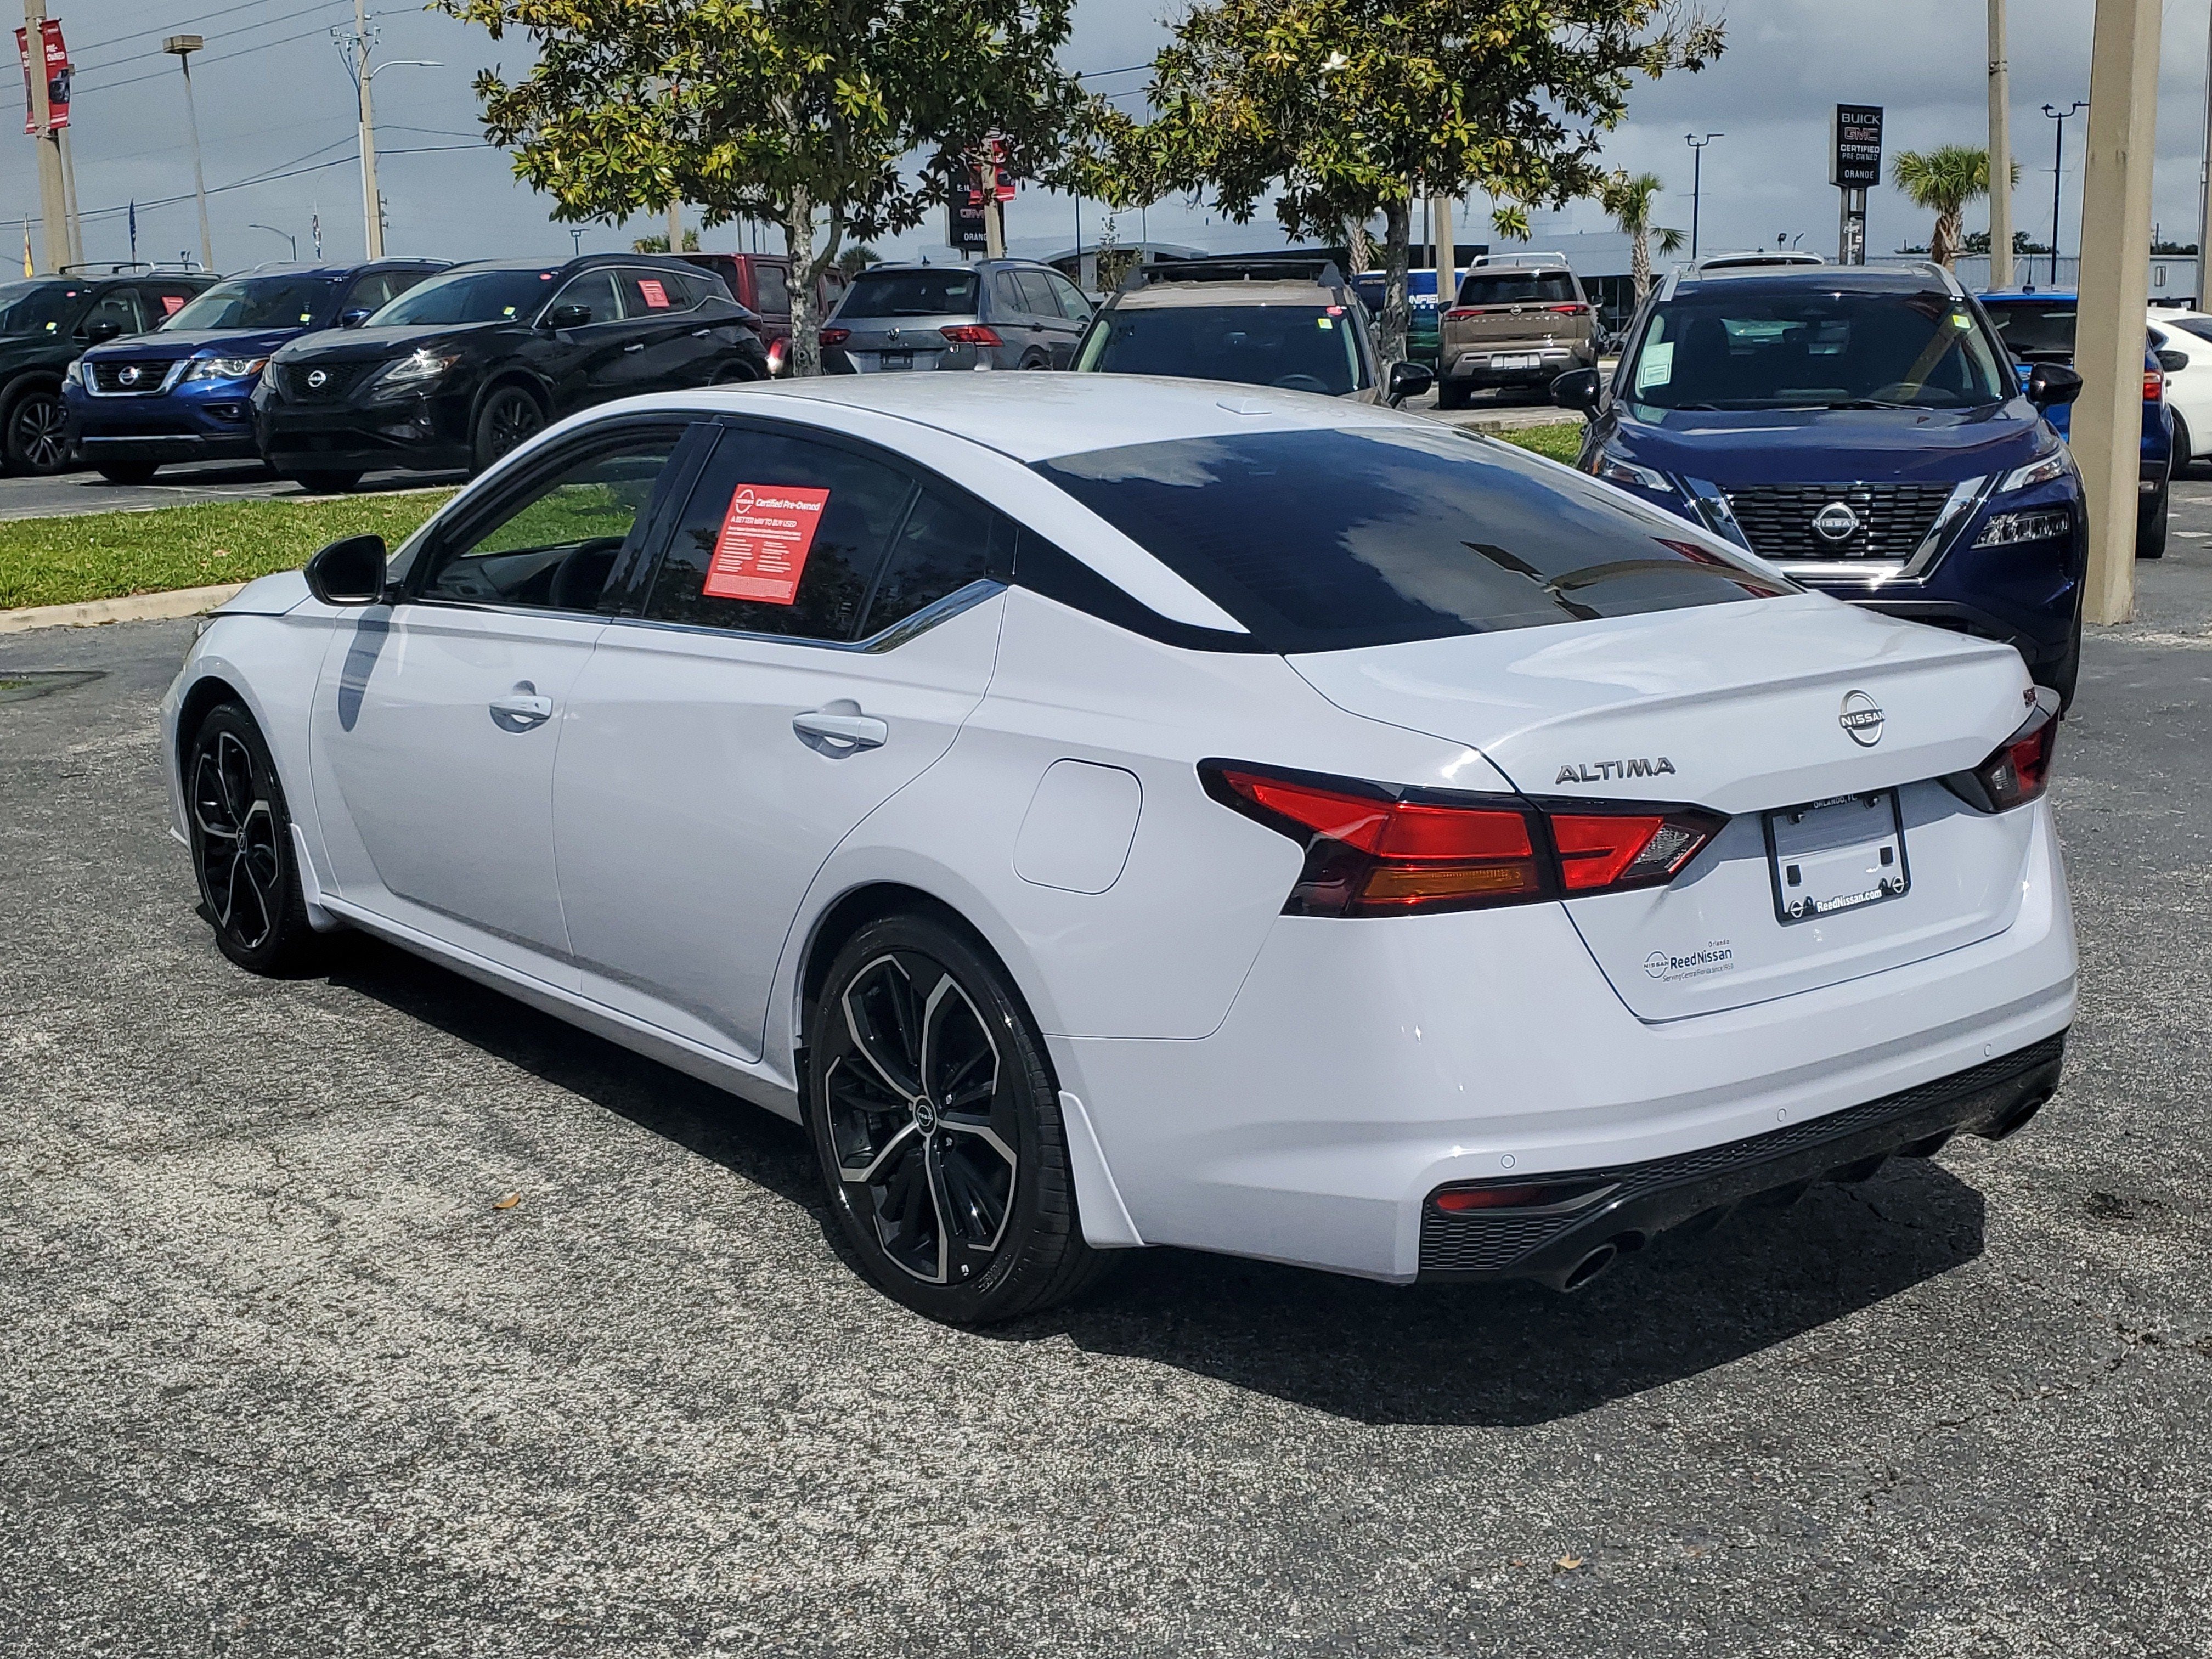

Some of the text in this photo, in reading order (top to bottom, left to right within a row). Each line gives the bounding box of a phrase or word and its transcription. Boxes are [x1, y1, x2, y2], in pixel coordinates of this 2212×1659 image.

[1842, 113, 1881, 125] BUICK
[1844, 127, 1878, 141] GMC
[1841, 144, 1880, 153] CERTIFIED
[1842, 153, 1878, 161] PRE-OWNED
[1844, 170, 1875, 179] ORANGE
[960, 208, 985, 218] GM
[756, 498, 783, 508] Certified
[783, 500, 821, 511] Pre-Owned
[1841, 711, 1884, 726] NISSAN
[1555, 757, 1677, 785] ALTIMA
[1817, 889, 1882, 912] ReedNissan.com
[1708, 939, 1730, 947] Orlando
